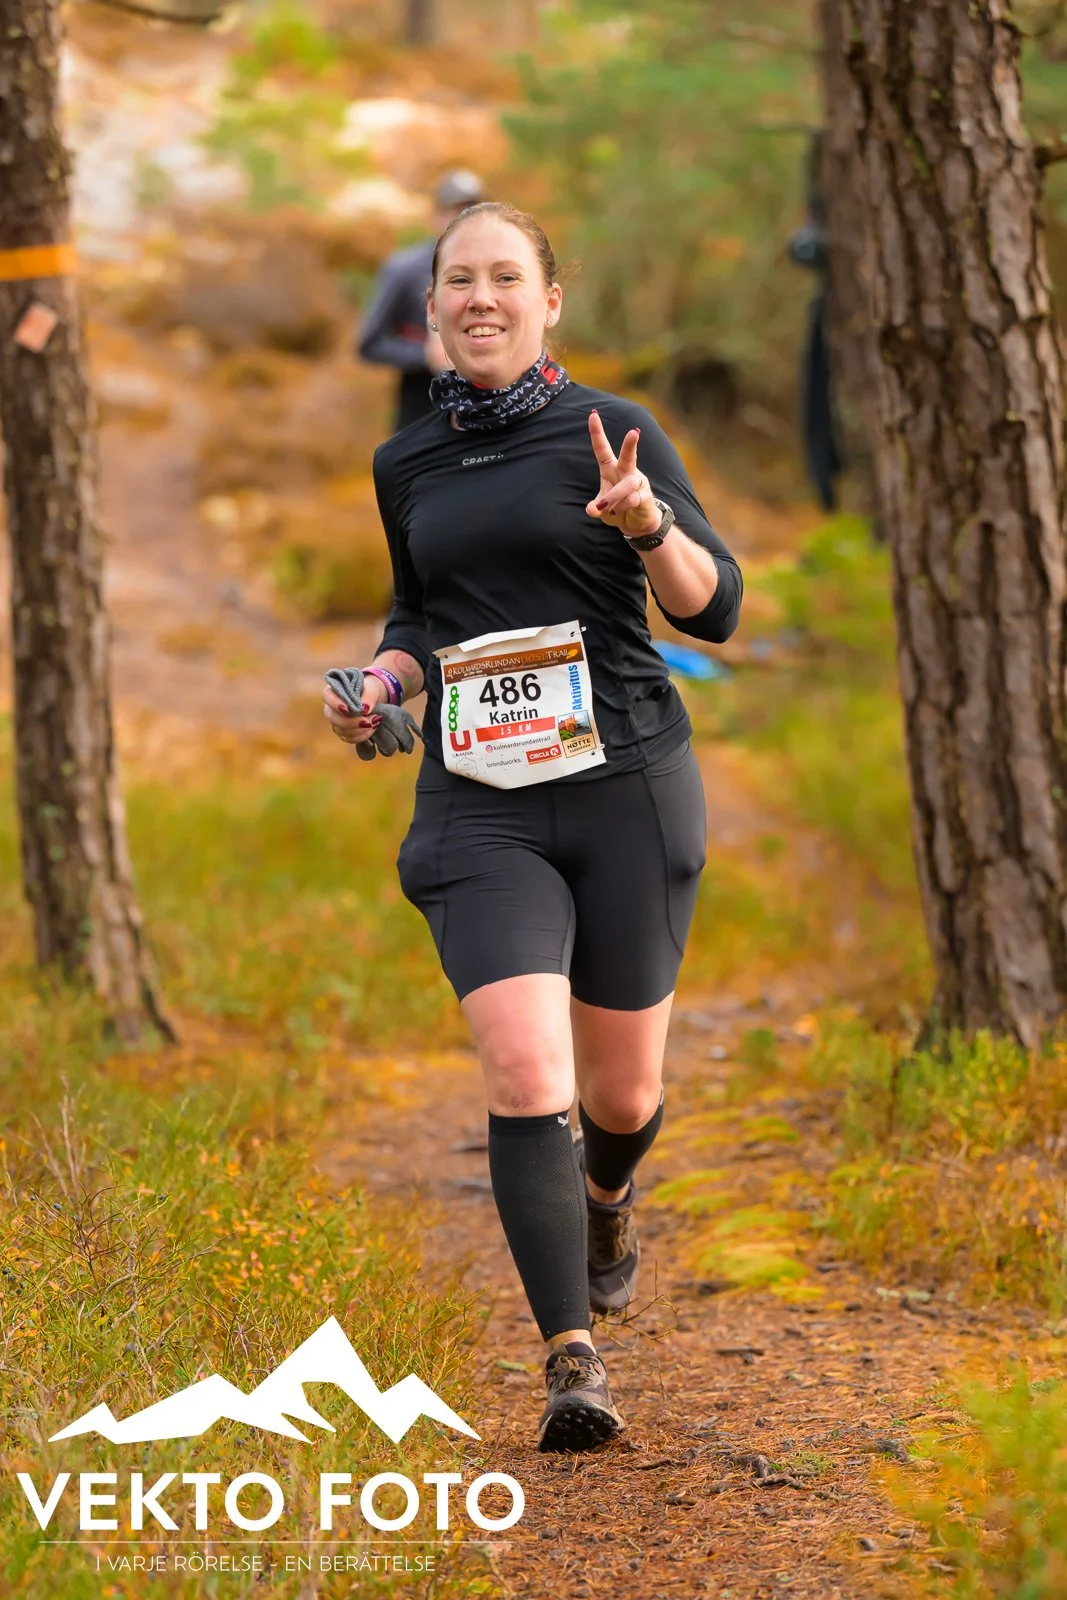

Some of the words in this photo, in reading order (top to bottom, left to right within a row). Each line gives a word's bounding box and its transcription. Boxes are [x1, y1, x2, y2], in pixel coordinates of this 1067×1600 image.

[479, 673, 541, 708] 486
[568, 664, 582, 710] Aktivitus
[448, 685, 459, 732] coop
[489, 706, 539, 725] Katrin
[500, 725, 512, 736] 15
[518, 723, 532, 733] KM
[529, 751, 550, 760] CIRCLE
